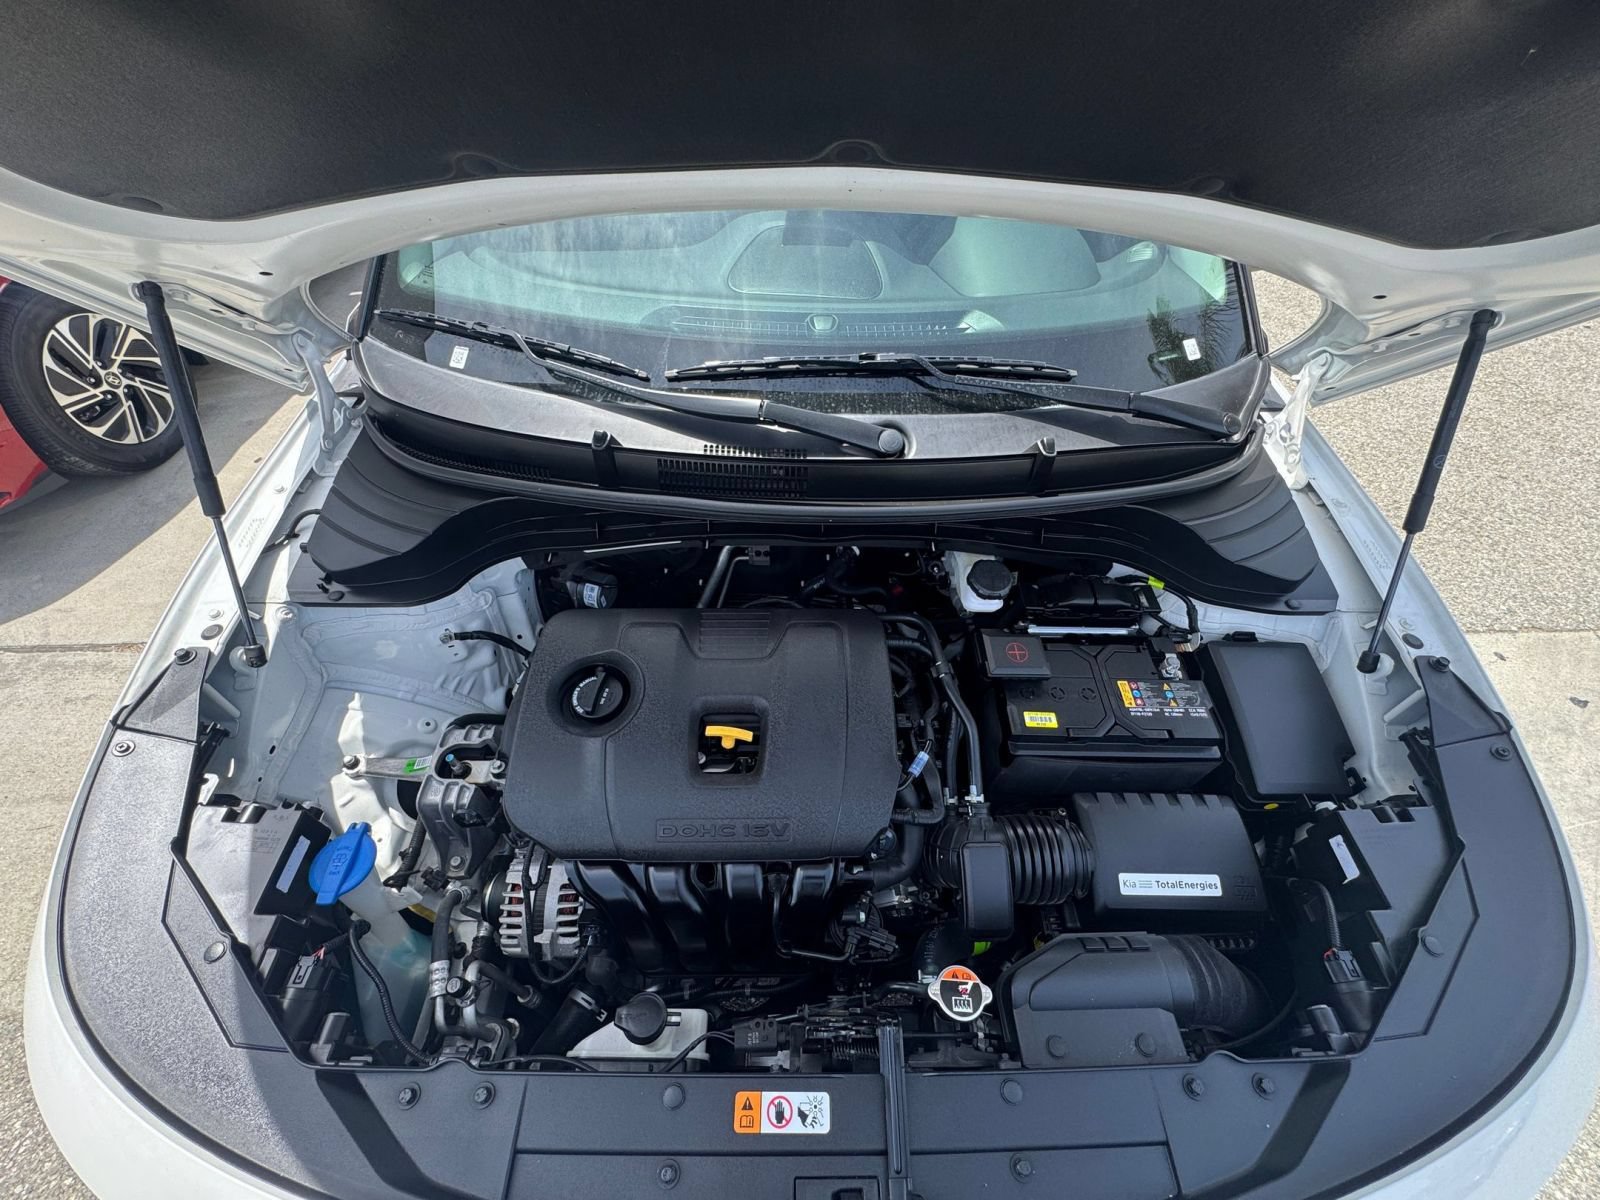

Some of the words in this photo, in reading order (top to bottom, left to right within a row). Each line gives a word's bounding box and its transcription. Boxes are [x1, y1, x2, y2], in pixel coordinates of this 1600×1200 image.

[658, 823, 737, 838] DOHC
[745, 822, 792, 837] 16V
[1122, 880, 1137, 889] Kia
[1155, 880, 1219, 891] TotalEnergies
